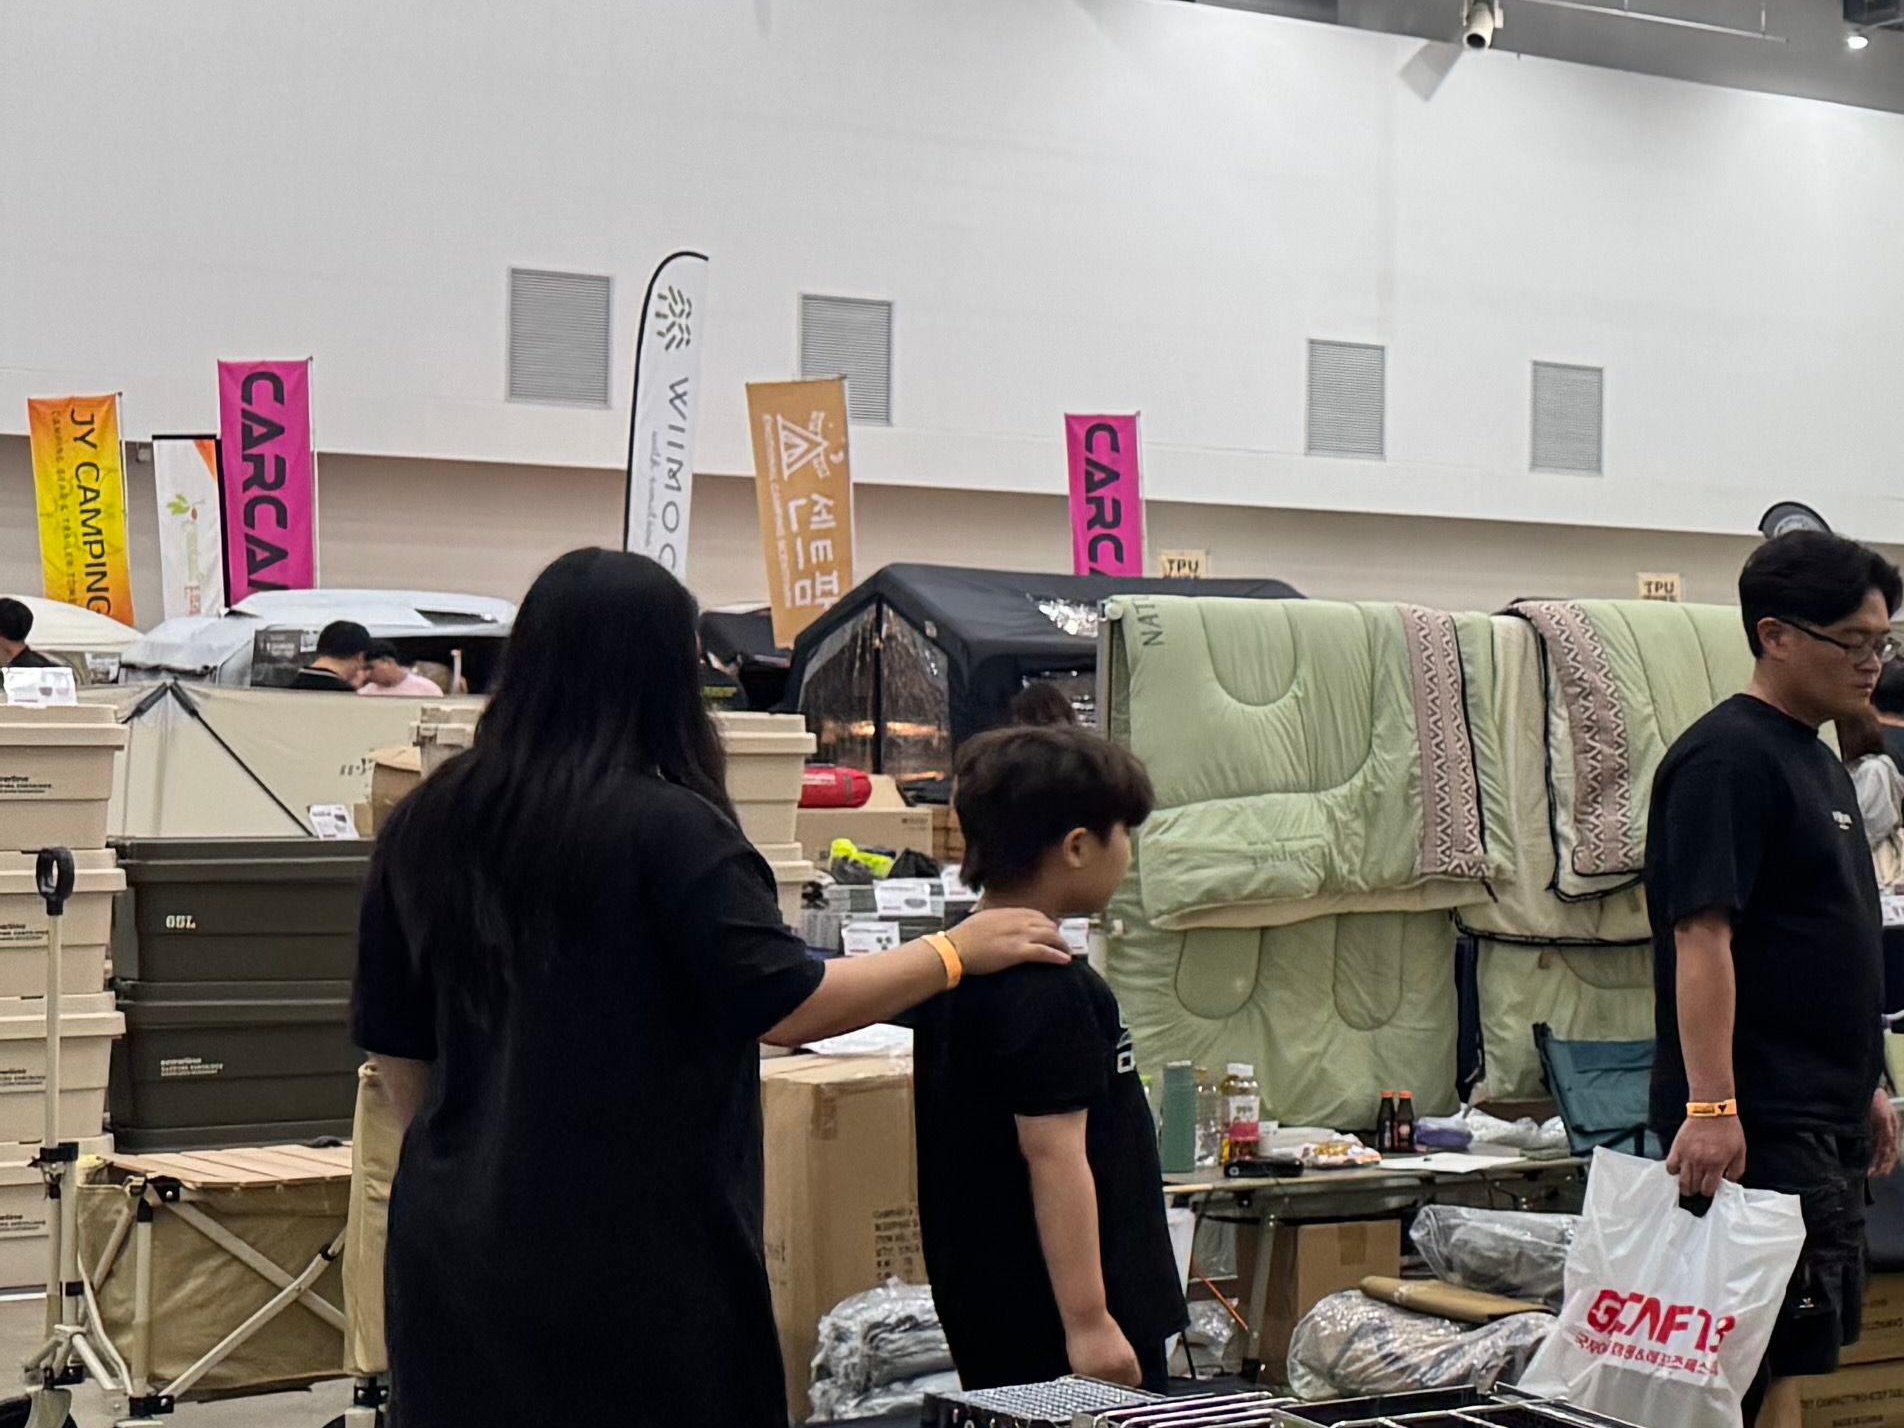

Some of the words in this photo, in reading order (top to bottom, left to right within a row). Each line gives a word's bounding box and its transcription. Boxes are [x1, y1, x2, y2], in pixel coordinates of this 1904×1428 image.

[71, 408, 98, 450] JY
[1085, 423, 1124, 577] CARC
[75, 460, 112, 617] CAMPING
